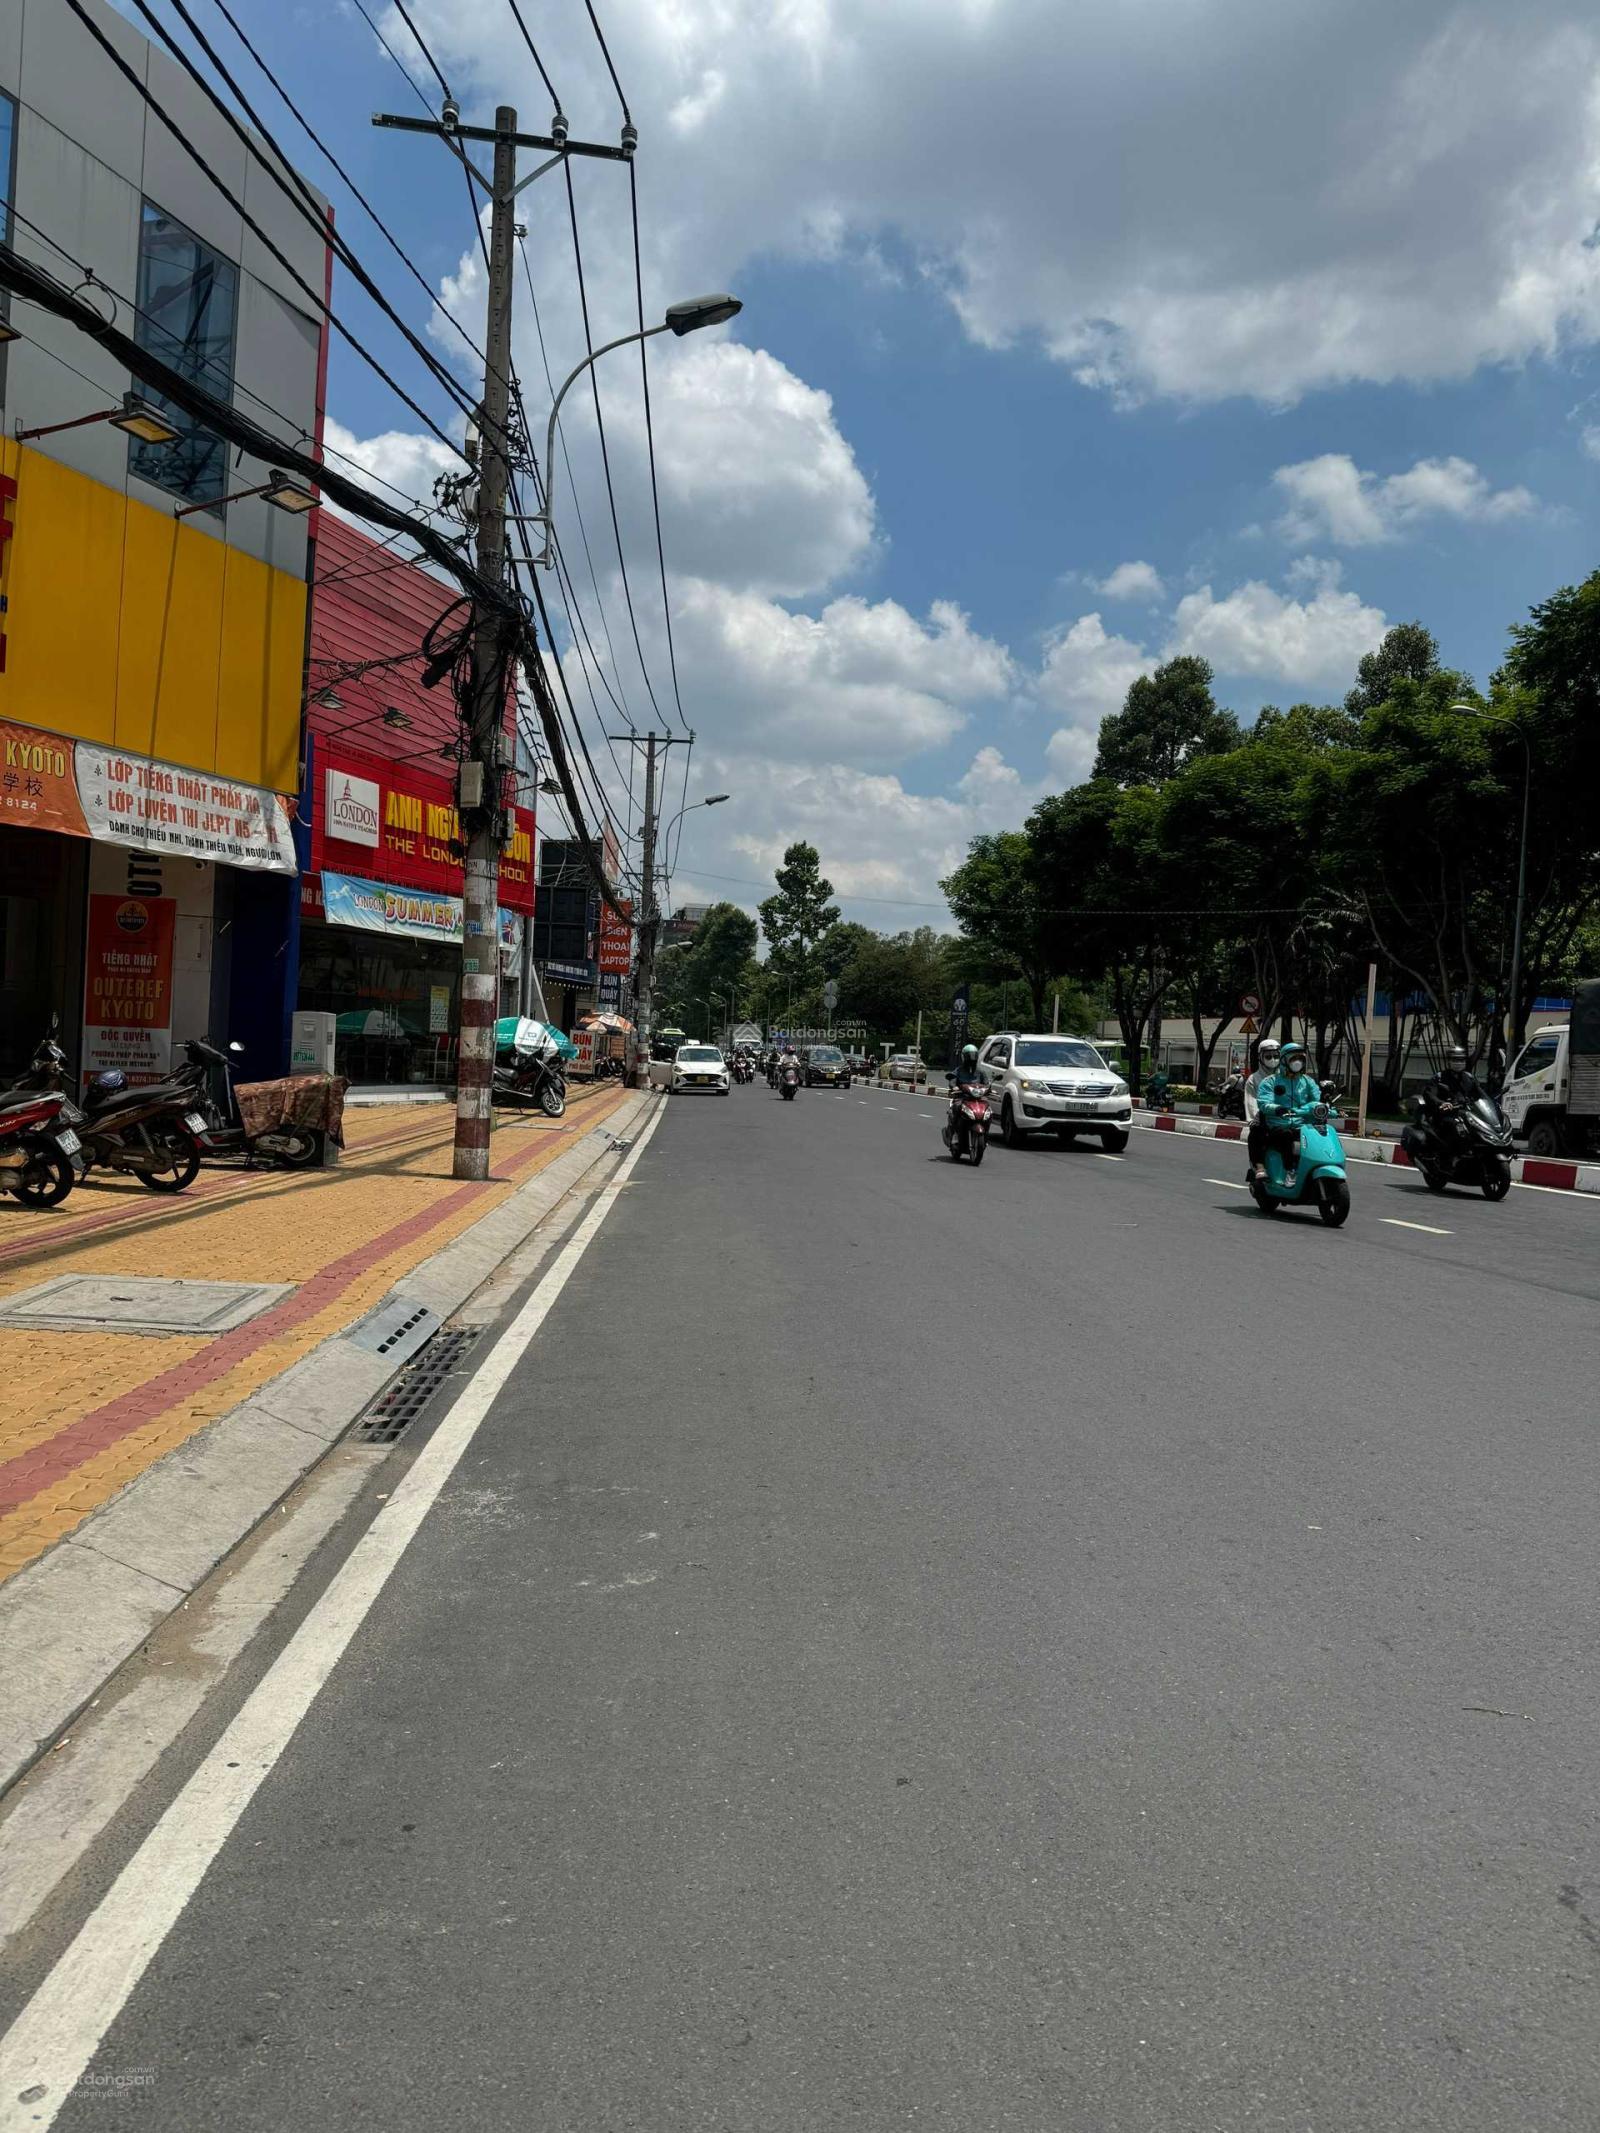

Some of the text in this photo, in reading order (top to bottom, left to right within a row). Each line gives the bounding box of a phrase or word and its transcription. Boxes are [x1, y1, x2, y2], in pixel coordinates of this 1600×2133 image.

[6, 739, 66, 778] KYOTO
[3, 771, 44, 798] 学校
[107, 758, 133, 785] LỚP
[137, 763, 173, 794] TIẾNG
[177, 778, 207, 805] NHẬT
[108, 788, 134, 813] LỚP
[137, 796, 177, 827] LUYỆN
[181, 806, 198, 829] THI
[202, 811, 231, 835] JLPT
[334, 799, 378, 828] LONDON
[385, 790, 423, 834] ANH
[109, 820, 130, 835] DÀNH
[131, 826, 145, 838] CHO
[146, 826, 167, 842] THIẾU
[206, 838, 226, 853] THIẾU
[385, 834, 416, 856] THE
[499, 864, 529, 884] HOOL
[354, 894, 385, 912] LONDON
[385, 892, 456, 932] SUMMER
[600, 955, 630, 966] LAPTOP
[602, 941, 630, 953] THOẠI
[101, 999, 155, 1021] KYOTO
[573, 1032, 592, 1046] BÚN
